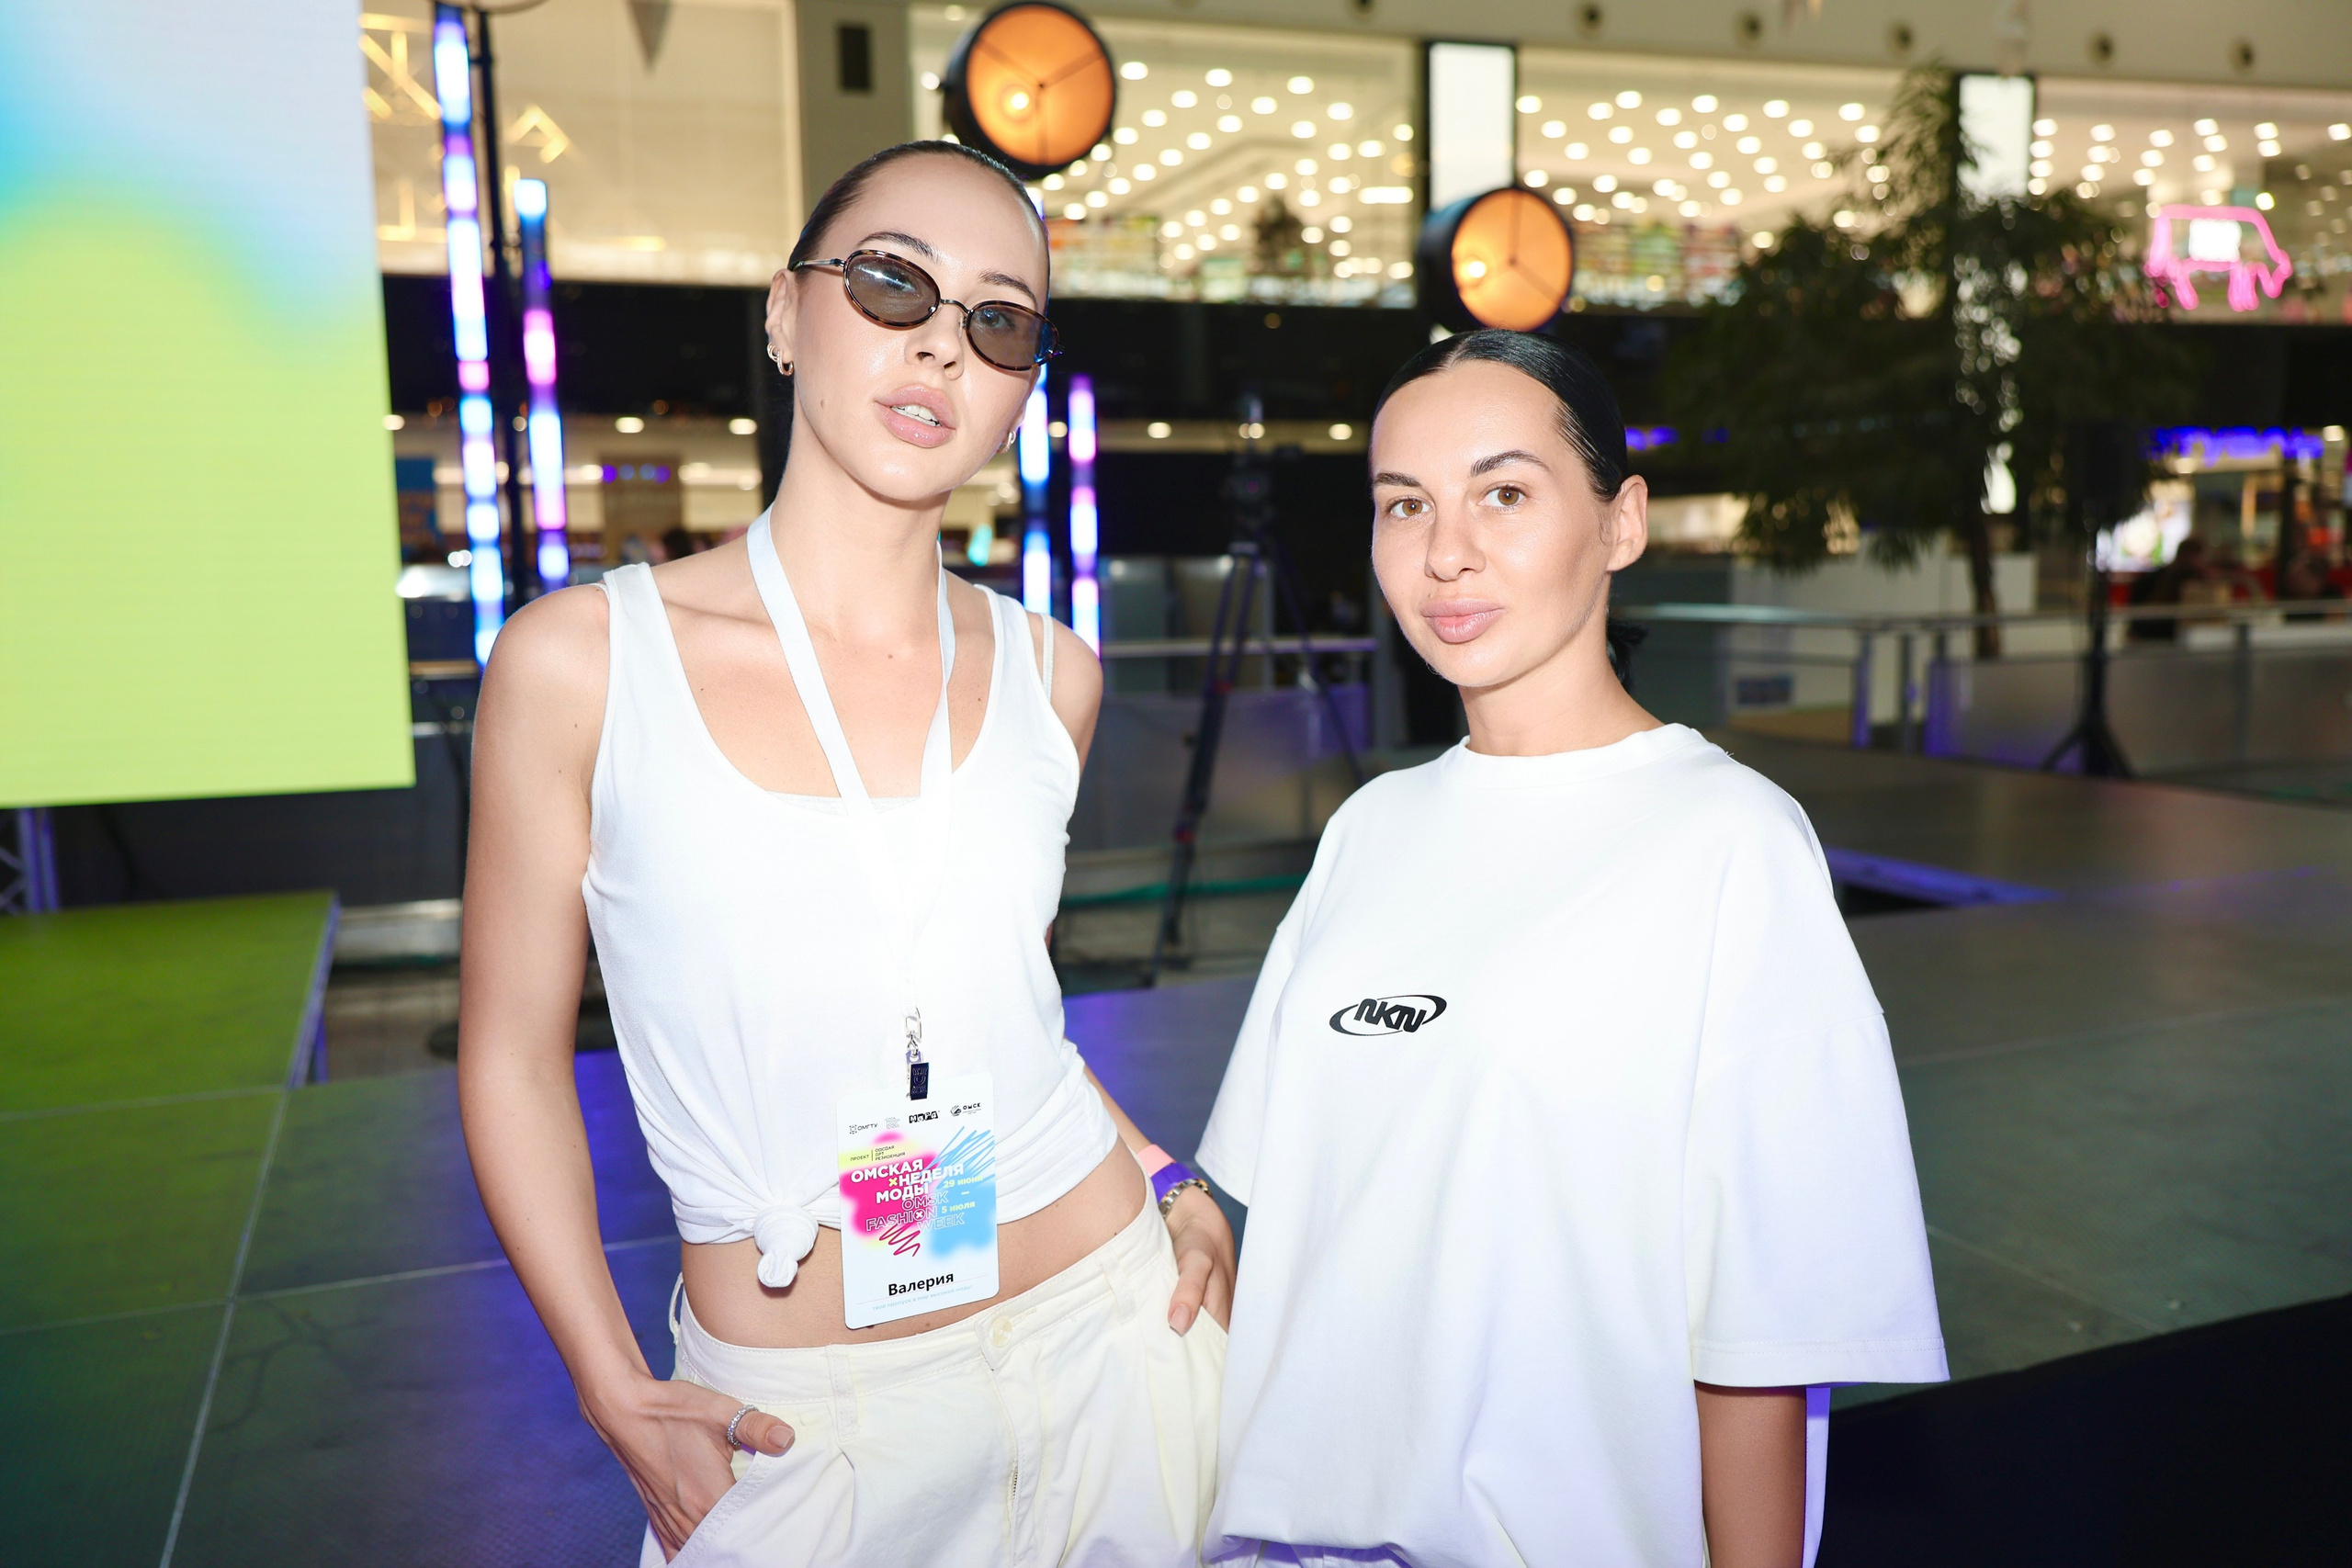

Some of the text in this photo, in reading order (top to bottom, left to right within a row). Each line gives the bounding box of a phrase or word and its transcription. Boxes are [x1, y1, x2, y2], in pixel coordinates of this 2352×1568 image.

[962, 1101, 981, 1111] ОМСК
[857, 1122, 878, 1132] ОМГТУ
[851, 1158, 923, 1183] ОМСКАЯ
[899, 1163, 965, 1187] НЕДЕЛЯ
[876, 1182, 930, 1204] МОДЫ
[944, 1179, 956, 1189] 29
[901, 1190, 949, 1211] OMSK
[941, 1201, 976, 1214] 5 июля
[865, 1206, 938, 1232] FASHION
[917, 1212, 966, 1233] WEEK
[888, 1273, 954, 1296] Валерия
[887, 1298, 911, 1308] пропуск
[930, 1288, 956, 1298] высокой
